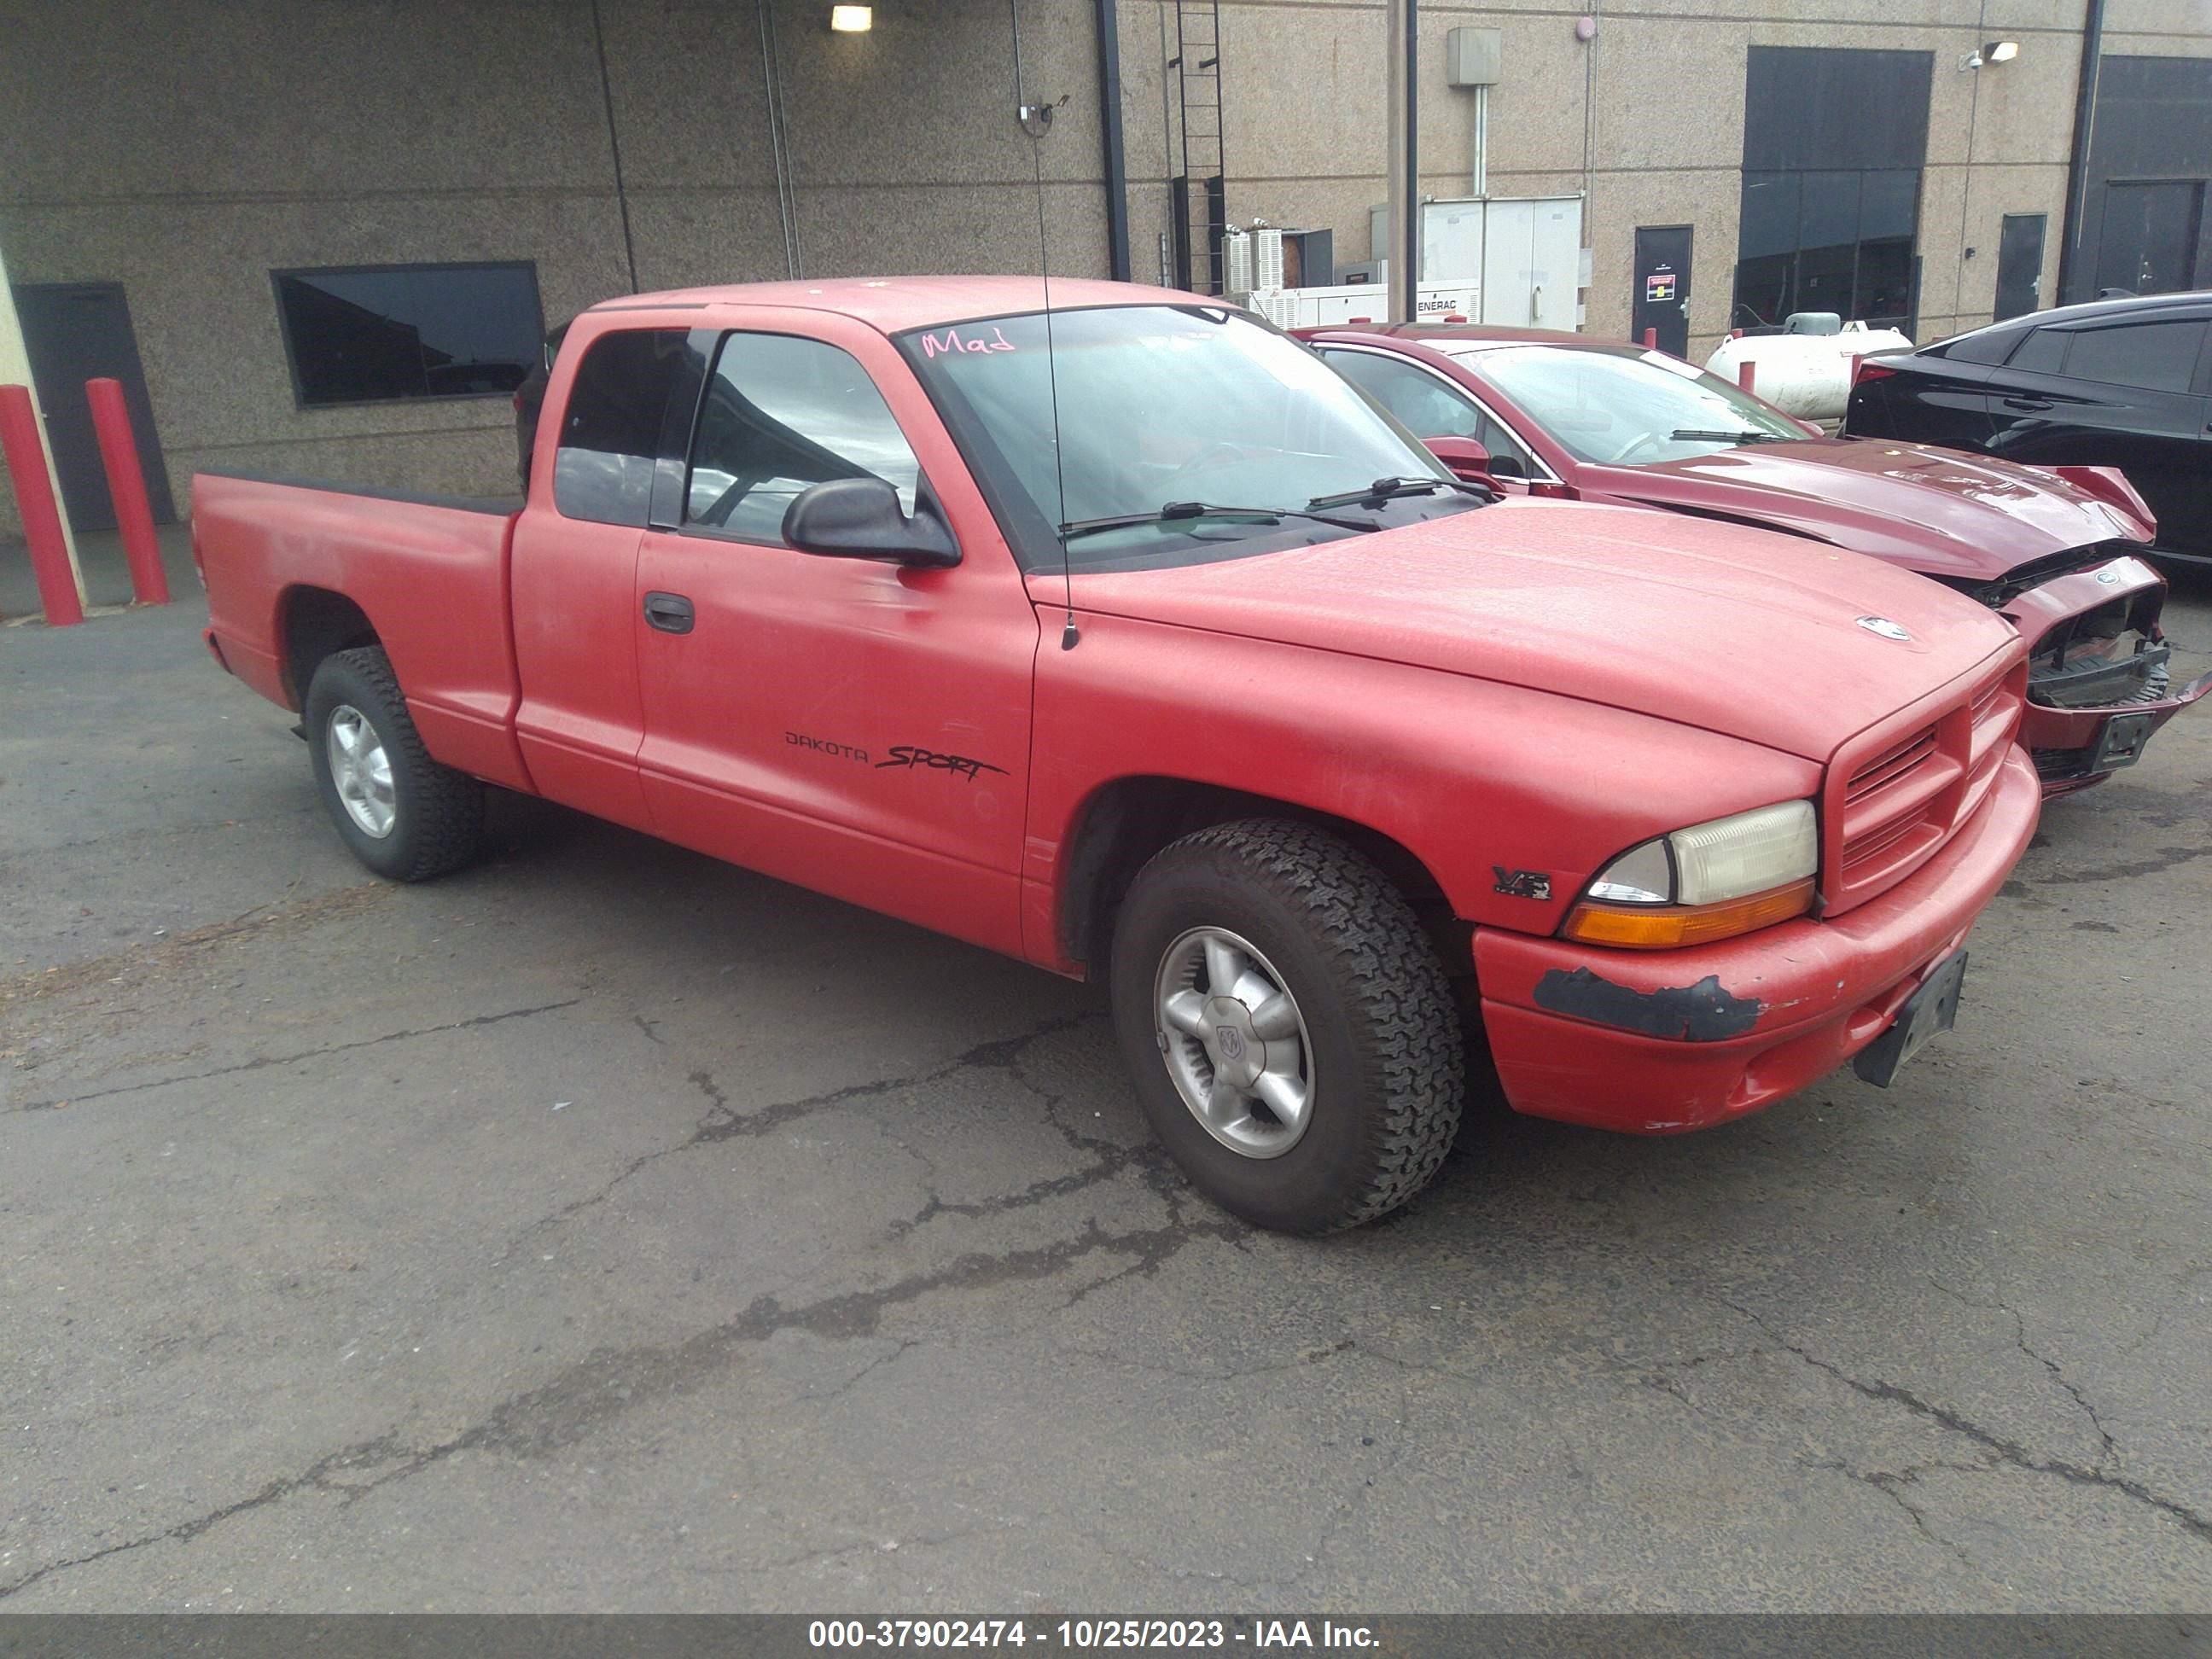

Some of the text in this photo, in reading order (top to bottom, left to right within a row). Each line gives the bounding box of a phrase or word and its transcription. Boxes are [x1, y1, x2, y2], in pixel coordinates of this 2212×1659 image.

[1417, 300, 1457, 311] ENERAC
[922, 327, 1016, 358] Mad
[784, 731, 1011, 783] DAKOTA SPORT
